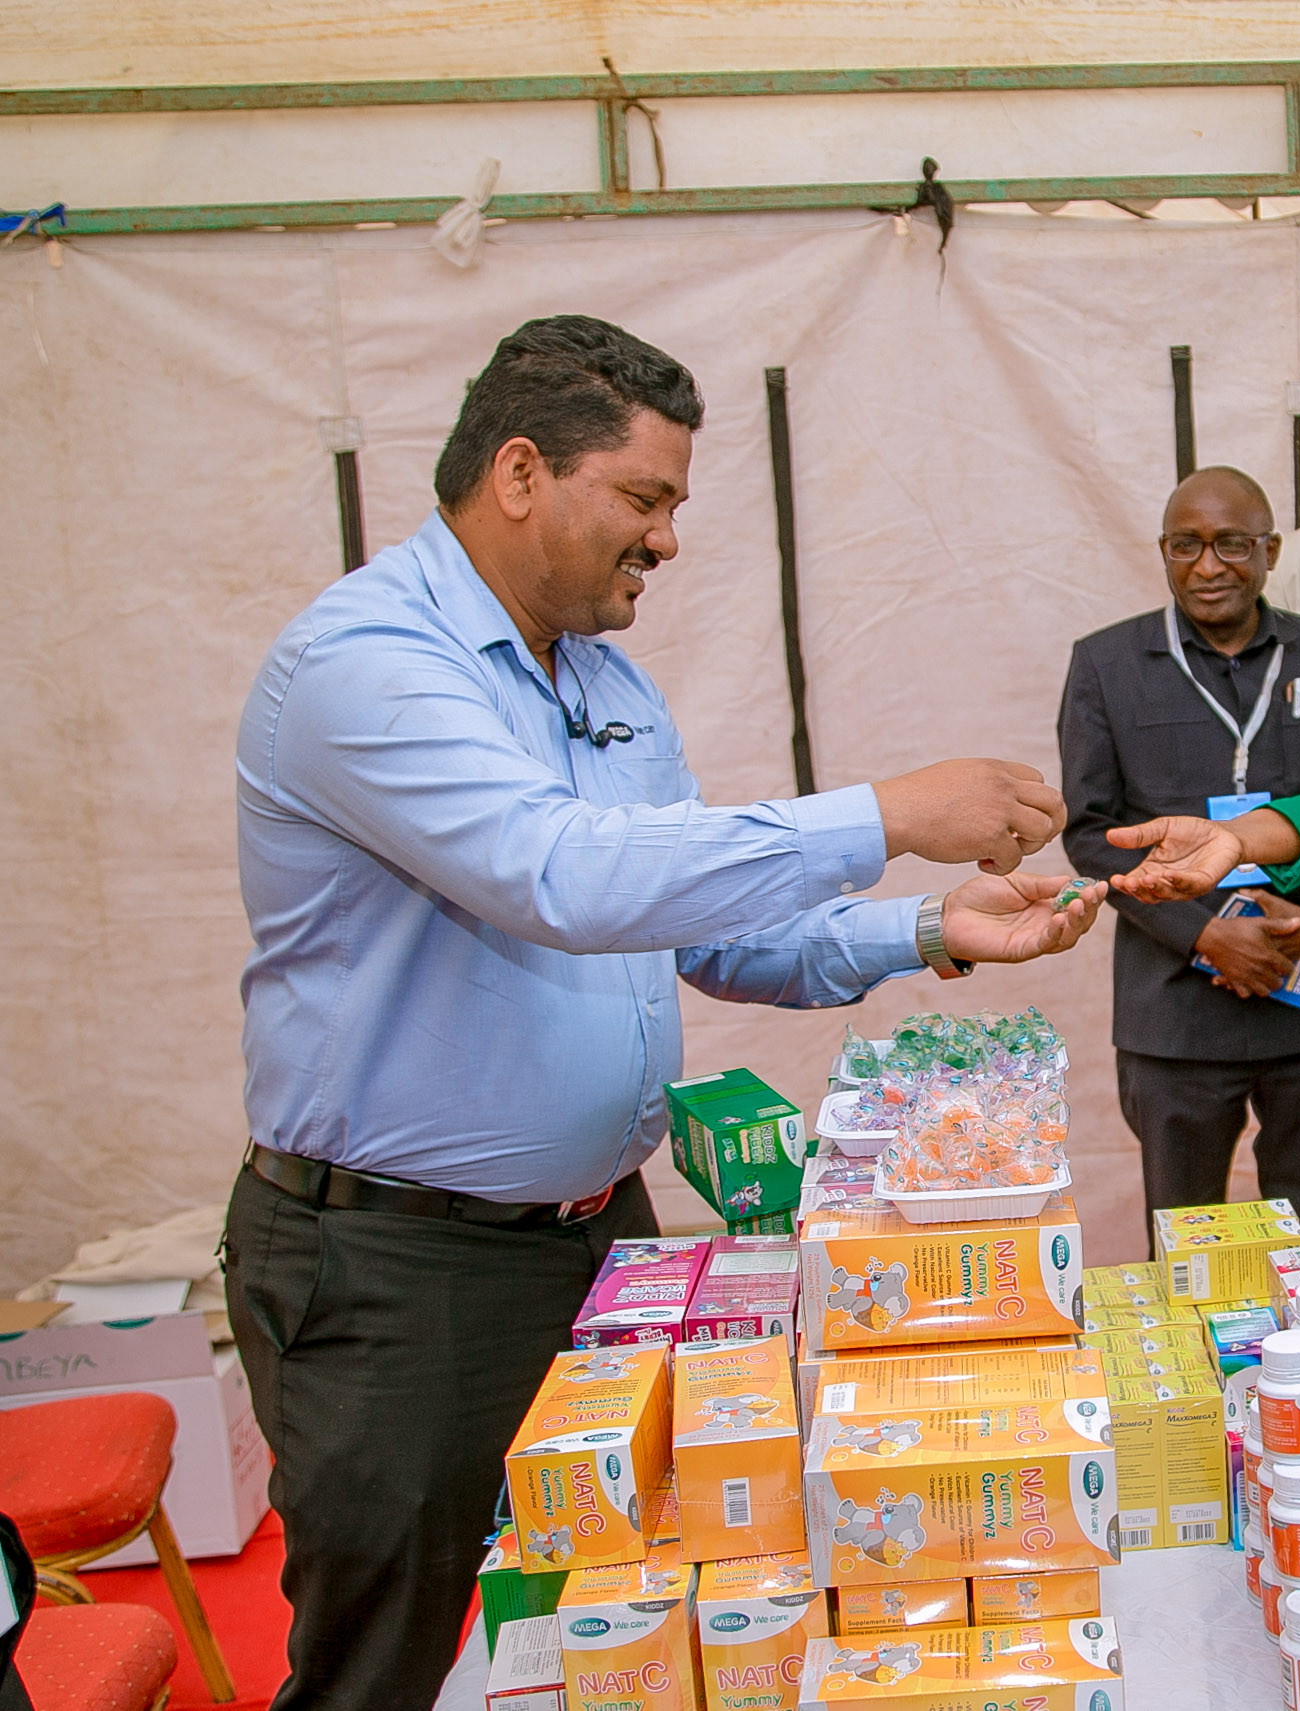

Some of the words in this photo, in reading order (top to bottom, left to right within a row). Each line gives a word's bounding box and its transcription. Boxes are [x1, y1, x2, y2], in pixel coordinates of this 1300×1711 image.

[747, 1127, 764, 1165] FIBER
[761, 1124, 777, 1165] KIDDZ
[1056, 1239, 1067, 1268] MEGA
[960, 1244, 974, 1307] Gummyz
[976, 1243, 990, 1297] Yummy
[994, 1239, 1019, 1294] NAT
[1058, 1273, 1066, 1287] We
[612, 1291, 686, 1304] KIDDZ
[1059, 1287, 1067, 1304] care
[995, 1295, 1026, 1320] C
[686, 1356, 741, 1370] NAT
[742, 1353, 769, 1365] C
[541, 1415, 571, 1429] C
[569, 1409, 631, 1424] NAT
[1014, 1429, 1049, 1445] C
[609, 1457, 619, 1479] MEGA
[527, 1470, 536, 1490] Orange
[553, 1467, 568, 1510] Yummy
[569, 1462, 598, 1513] NAT
[612, 1482, 620, 1492] We
[1087, 1465, 1099, 1496] MEGA
[531, 1491, 539, 1509] Flavor
[539, 1468, 555, 1517] Gummyz
[999, 1470, 1014, 1529] Yummy
[1018, 1467, 1047, 1524] NAT
[981, 1472, 997, 1541] Gummyz
[1089, 1502, 1099, 1515] We
[575, 1512, 606, 1537] C
[1091, 1516, 1100, 1535] care
[1021, 1526, 1056, 1553] C
[645, 1602, 665, 1610] KIDDZ
[786, 1596, 804, 1604] KIDDZ
[714, 1617, 747, 1627] MEGA
[754, 1615, 769, 1624] We
[770, 1614, 790, 1622] care
[848, 1617, 886, 1627] Supplement
[982, 1609, 1019, 1618] Supplement
[574, 1621, 608, 1633] MEGA
[614, 1621, 629, 1630] We
[631, 1619, 649, 1628] care
[716, 1664, 780, 1691] NAT
[780, 1653, 804, 1687] C
[1018, 1653, 1055, 1673] C
[577, 1669, 640, 1696] NAT
[640, 1660, 671, 1694] C
[720, 1693, 784, 1709] Yummy
